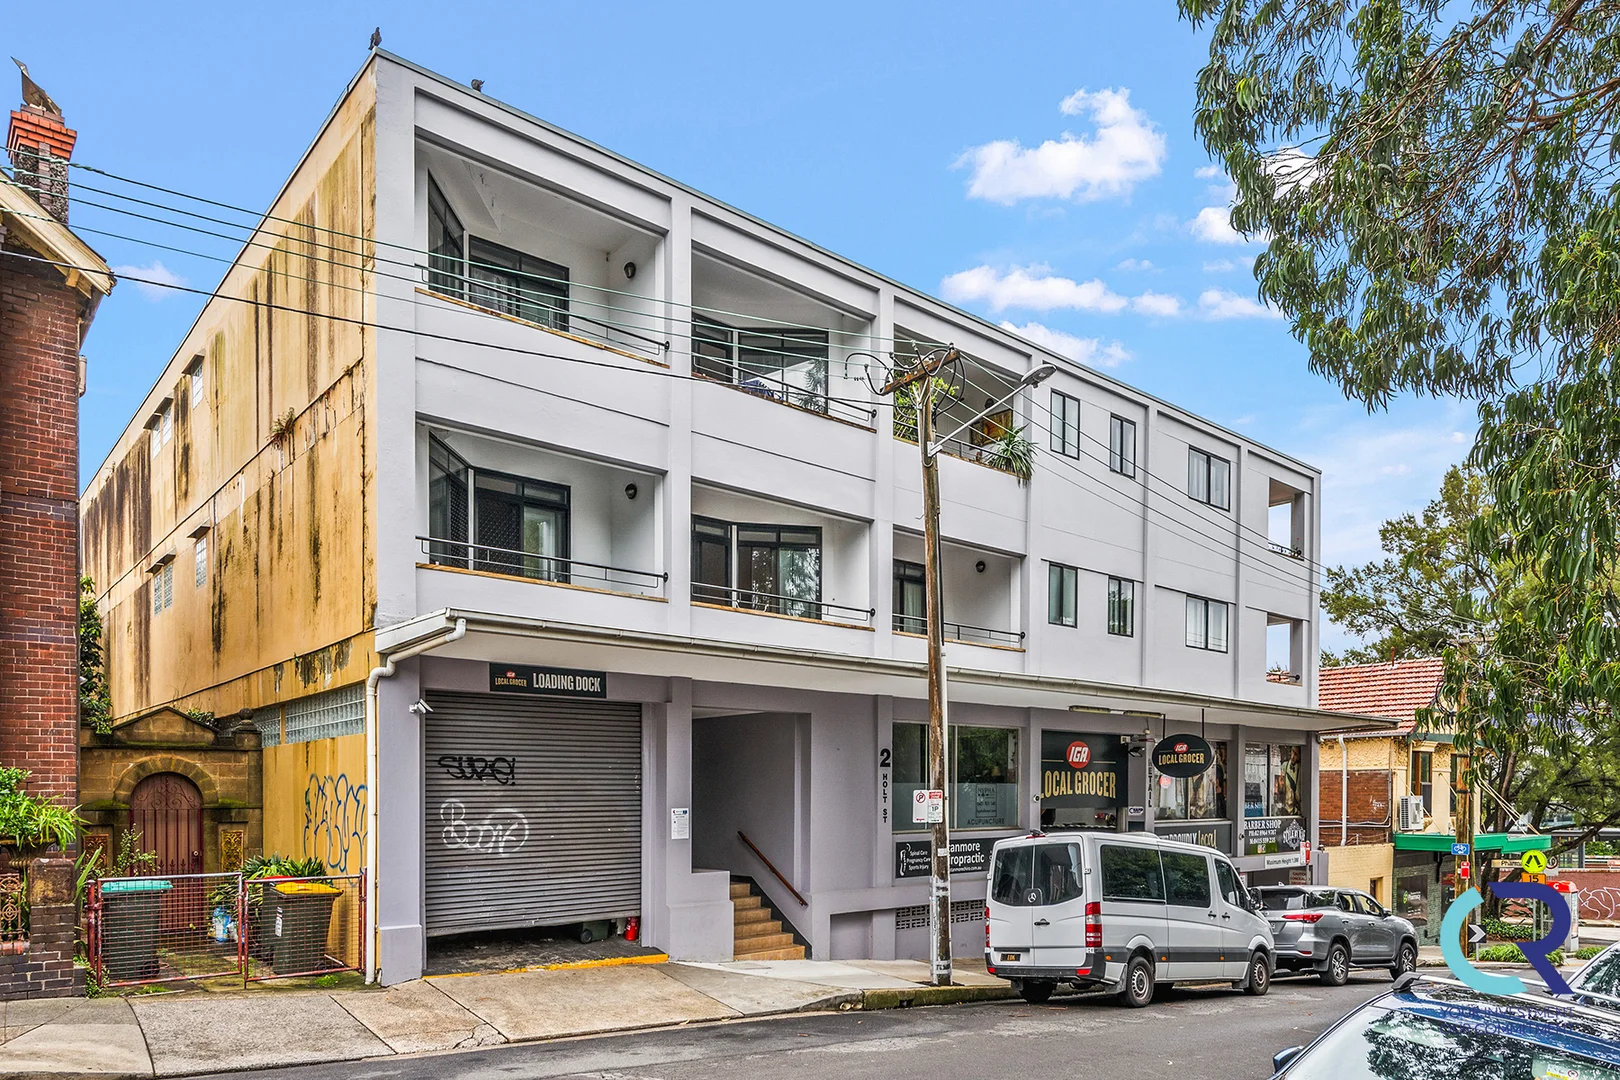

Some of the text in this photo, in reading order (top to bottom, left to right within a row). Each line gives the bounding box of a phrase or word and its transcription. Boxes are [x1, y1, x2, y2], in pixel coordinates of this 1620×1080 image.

[495, 677, 527, 687] LOCAL GROCER
[532, 672, 601, 692] LOADING DOCK
[1069, 746, 1088, 763] IGA
[1174, 744, 1187, 752] IGA
[879, 748, 891, 768] 2
[1158, 753, 1205, 766] LOCAL GROCER
[1075, 771, 1117, 799] GROCER
[882, 808, 888, 823] ST
[1244, 819, 1281, 830] BARBER SHOP
[949, 842, 981, 853] anmore
[949, 852, 985, 867] ropractic
[1282, 857, 1292, 865] Height
[1528, 874, 1539, 883] 15
